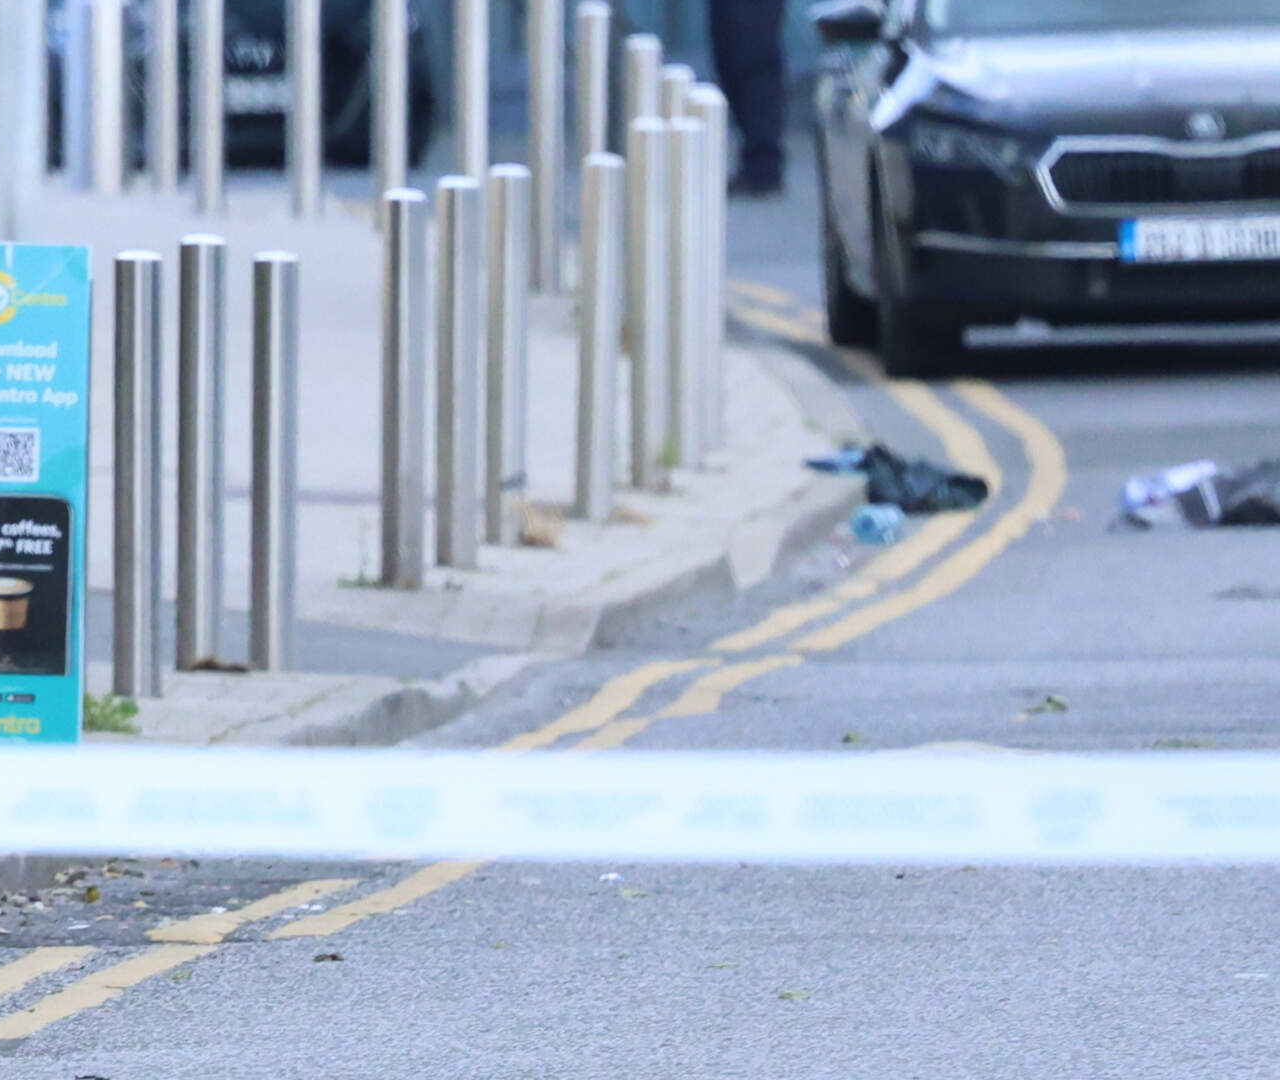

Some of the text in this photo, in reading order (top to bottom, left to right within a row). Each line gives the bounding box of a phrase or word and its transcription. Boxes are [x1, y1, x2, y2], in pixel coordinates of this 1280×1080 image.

[5, 364, 57, 383] NEW
[42, 386, 80, 408] App
[1, 519, 62, 538] coffees,
[15, 538, 54, 555] FREE
